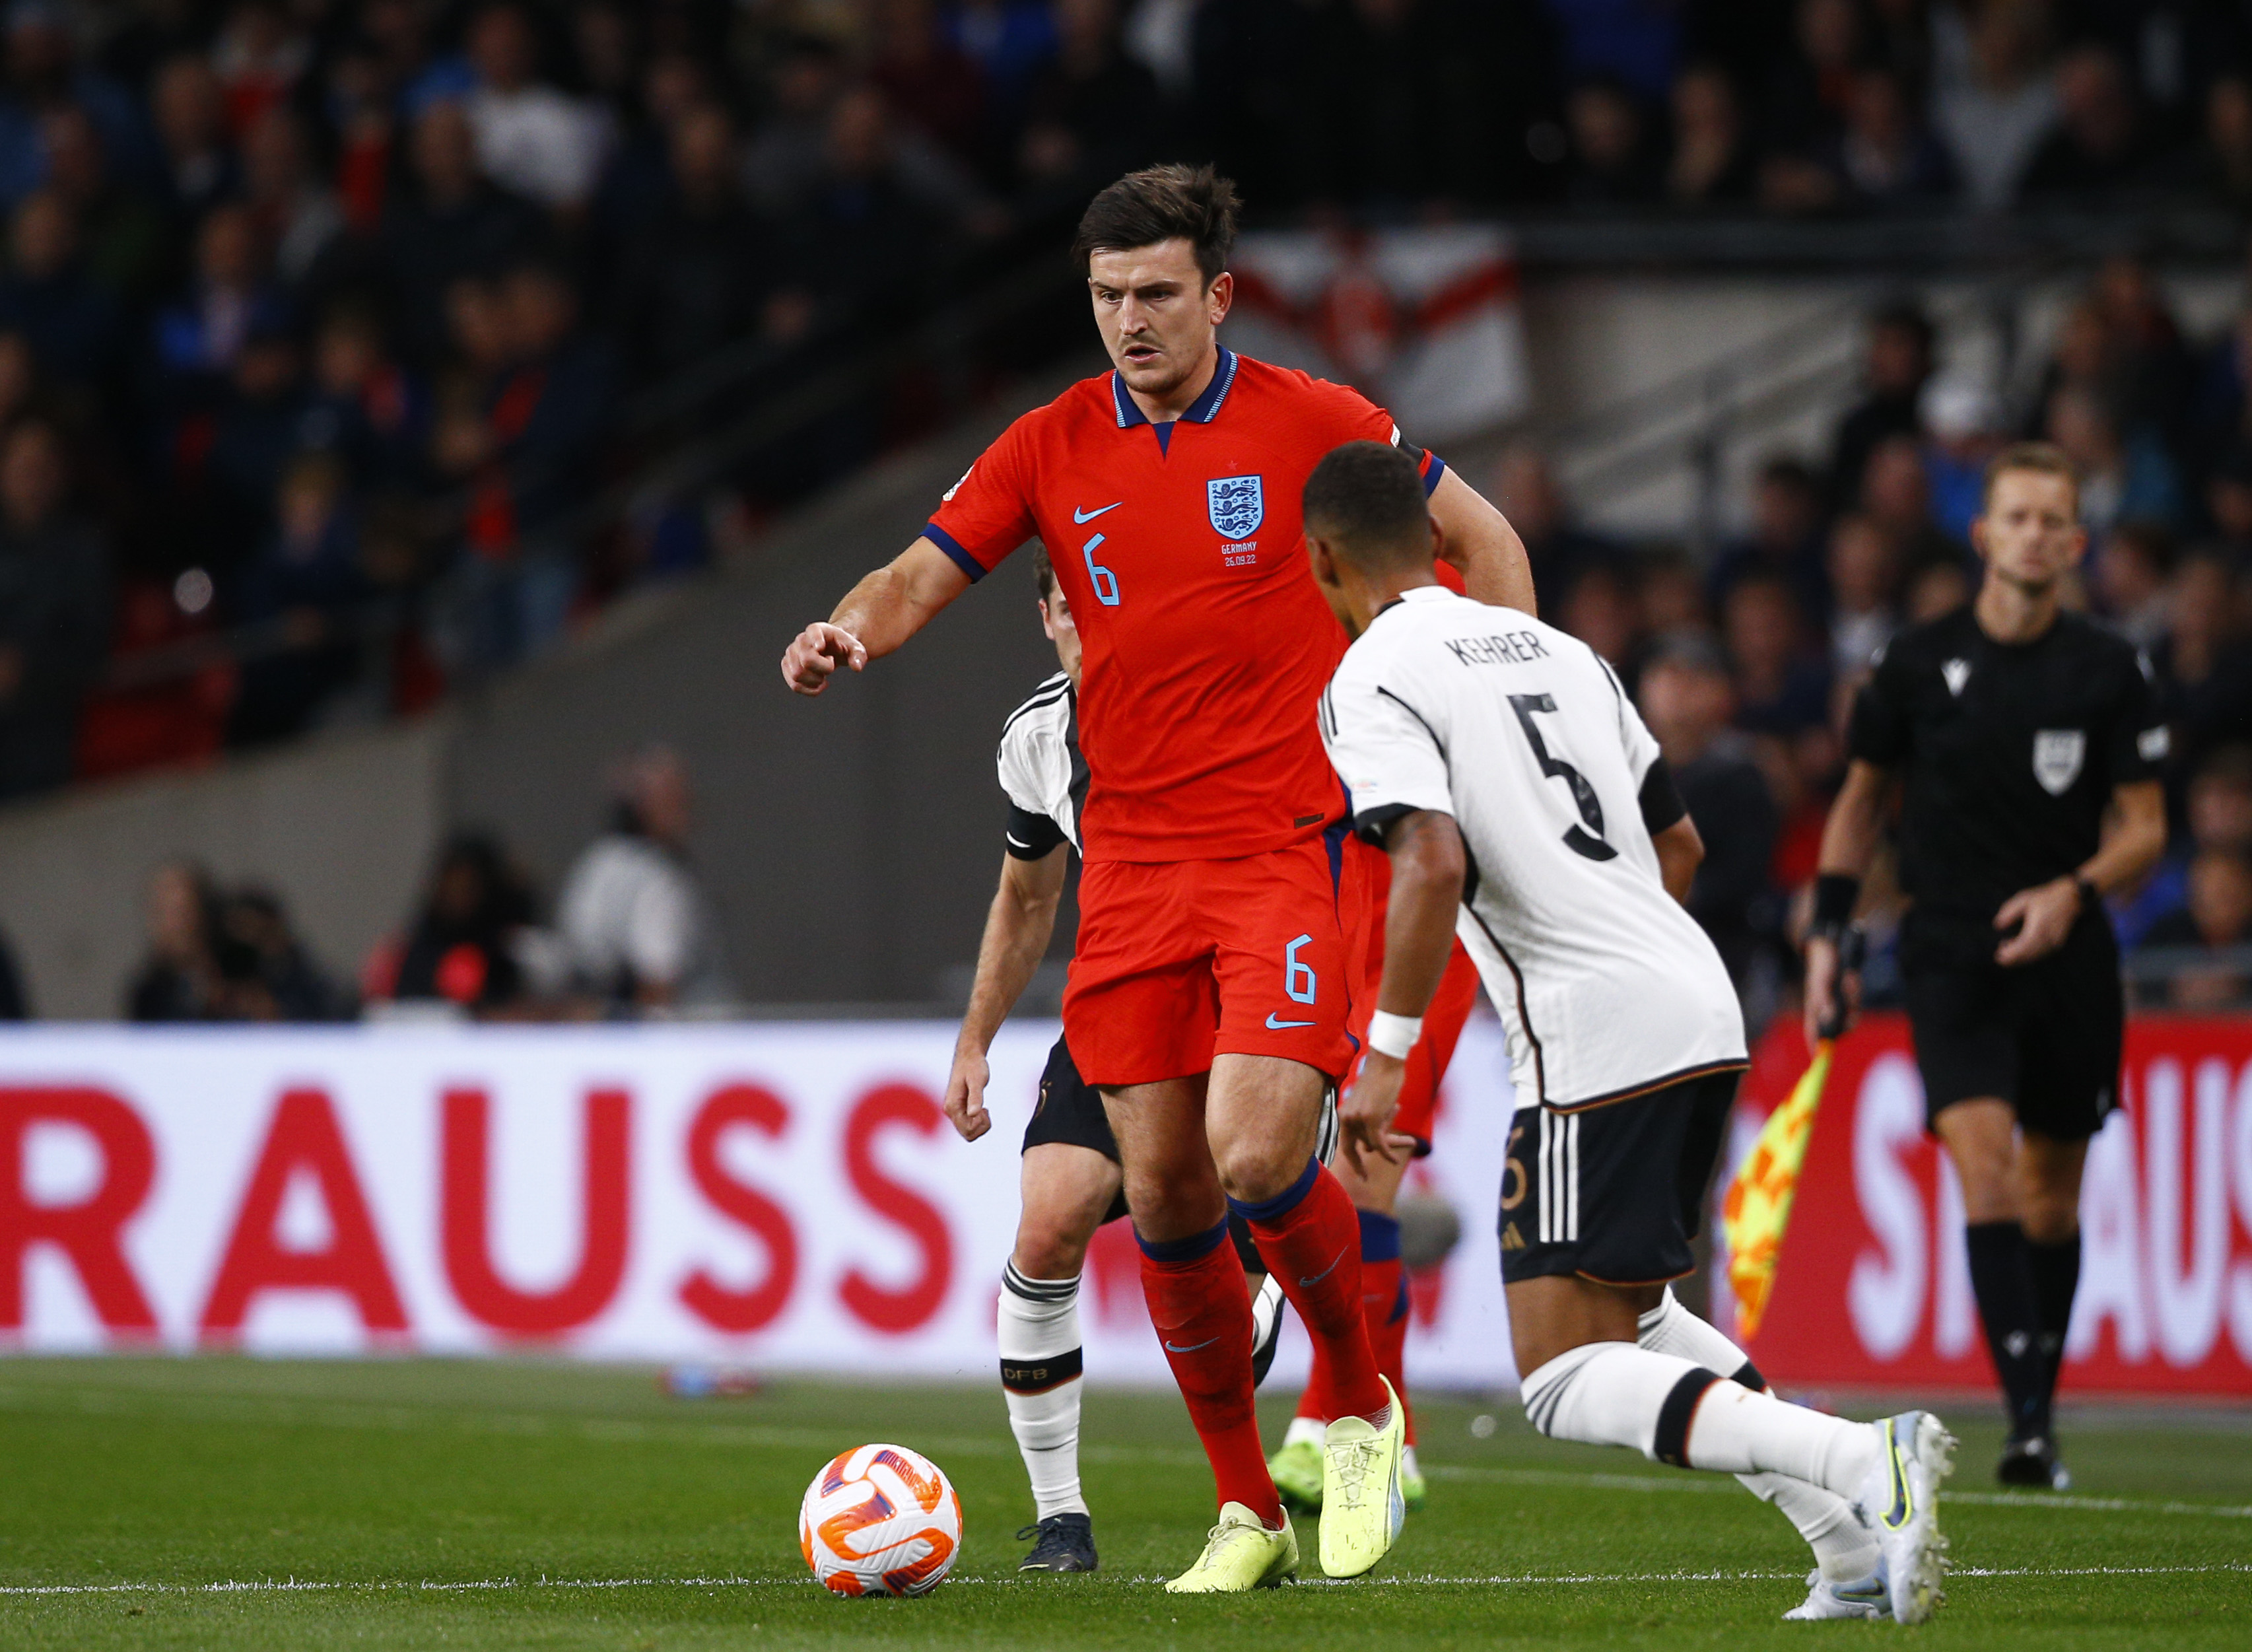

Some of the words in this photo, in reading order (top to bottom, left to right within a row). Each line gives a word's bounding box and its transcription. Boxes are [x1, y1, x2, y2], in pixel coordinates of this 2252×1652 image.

[1221, 541, 1257, 555] GERMANY
[1225, 554, 1256, 567] 26.09.22
[1083, 532, 1120, 606] 6
[1444, 631, 1550, 667] KEHRER
[1507, 693, 1618, 862] 5
[1285, 933, 1316, 1005] 6
[1003, 1367, 1048, 1381] DFB
